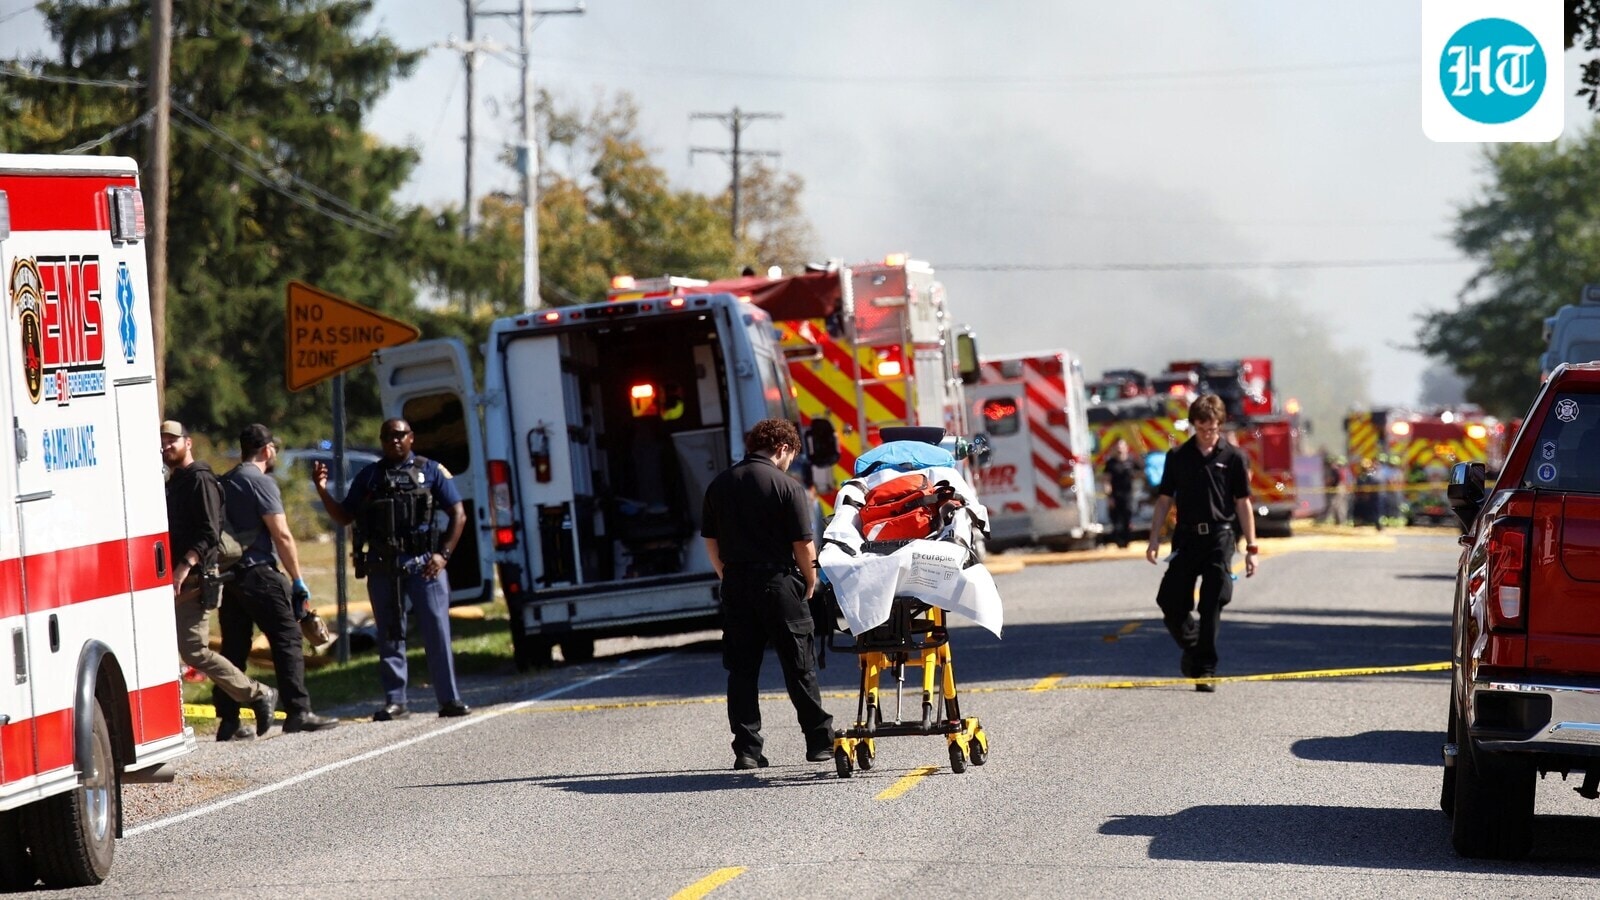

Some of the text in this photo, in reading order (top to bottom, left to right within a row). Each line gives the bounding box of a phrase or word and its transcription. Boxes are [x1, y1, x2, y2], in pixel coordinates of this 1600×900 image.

[37, 257, 105, 368] EMS
[295, 304, 323, 321] NO
[296, 325, 385, 344] PASSING
[297, 350, 338, 368] ZONE
[51, 425, 97, 470] AMBULANCE
